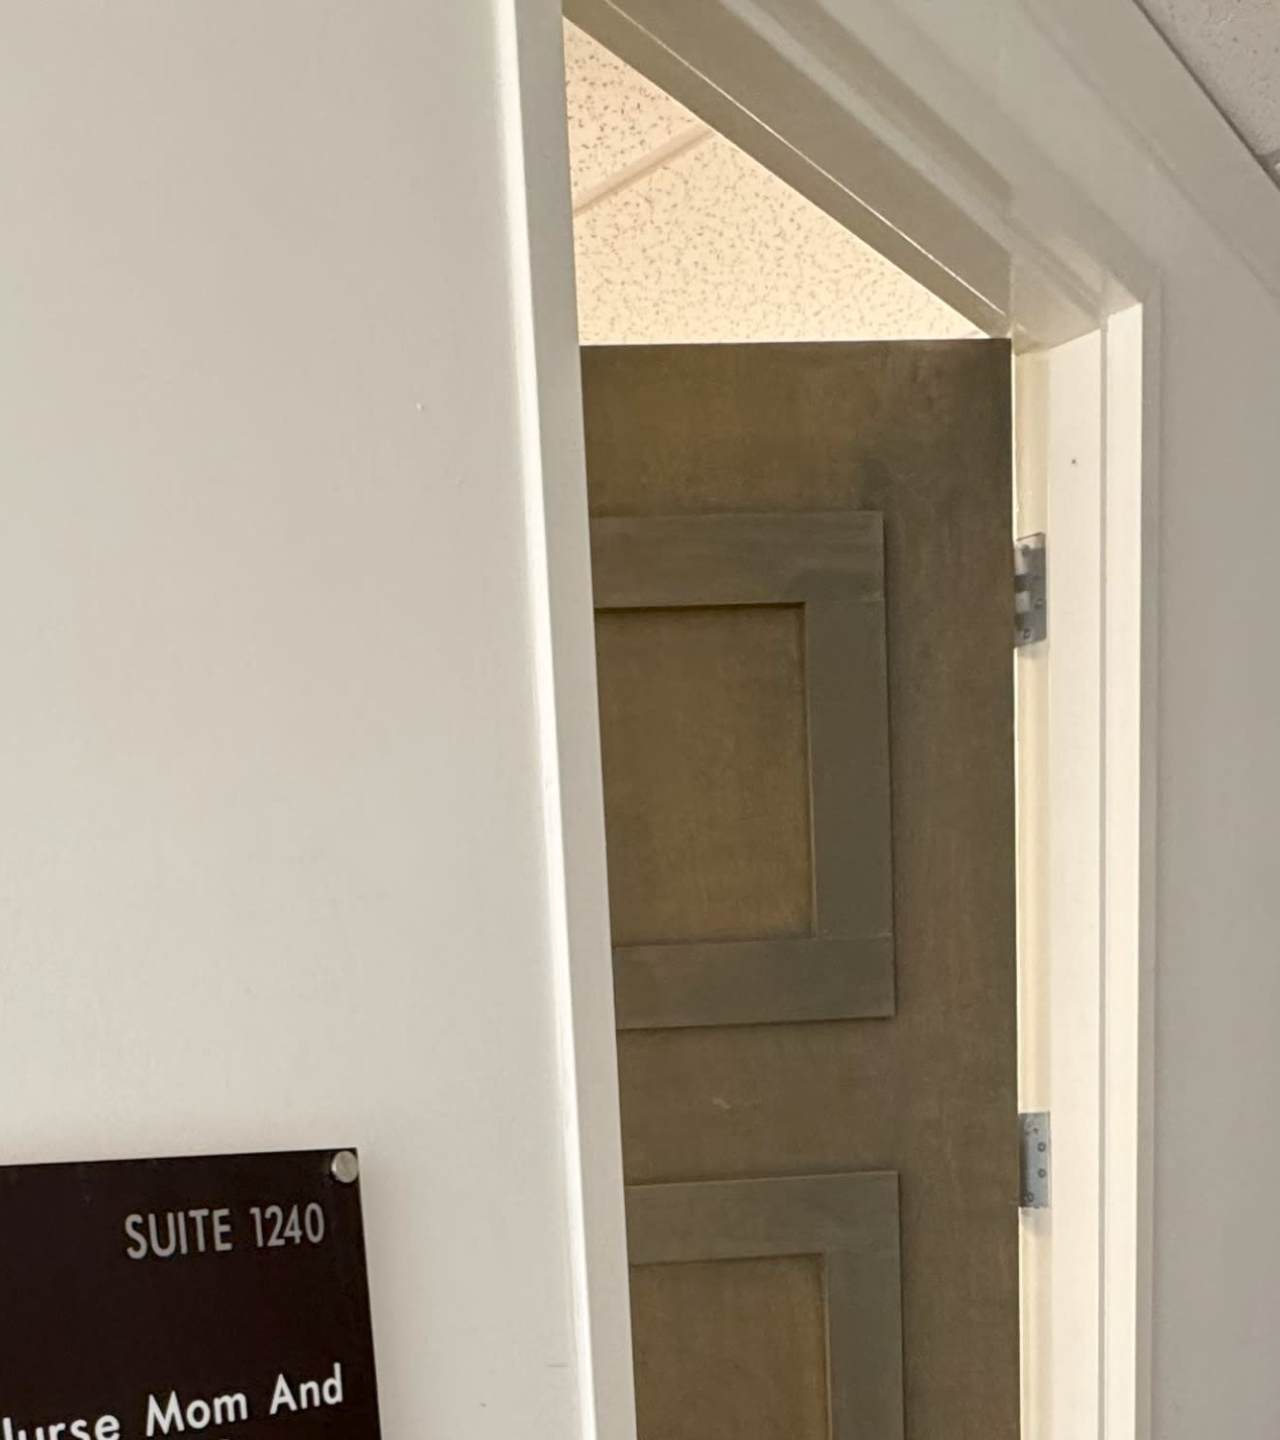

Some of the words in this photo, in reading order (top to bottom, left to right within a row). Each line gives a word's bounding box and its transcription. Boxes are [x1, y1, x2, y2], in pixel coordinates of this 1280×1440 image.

[124, 1208, 232, 1259] SUITE
[249, 1202, 324, 1247] 1240
[145, 1390, 249, 1437] Mom
[269, 1361, 344, 1415] And
